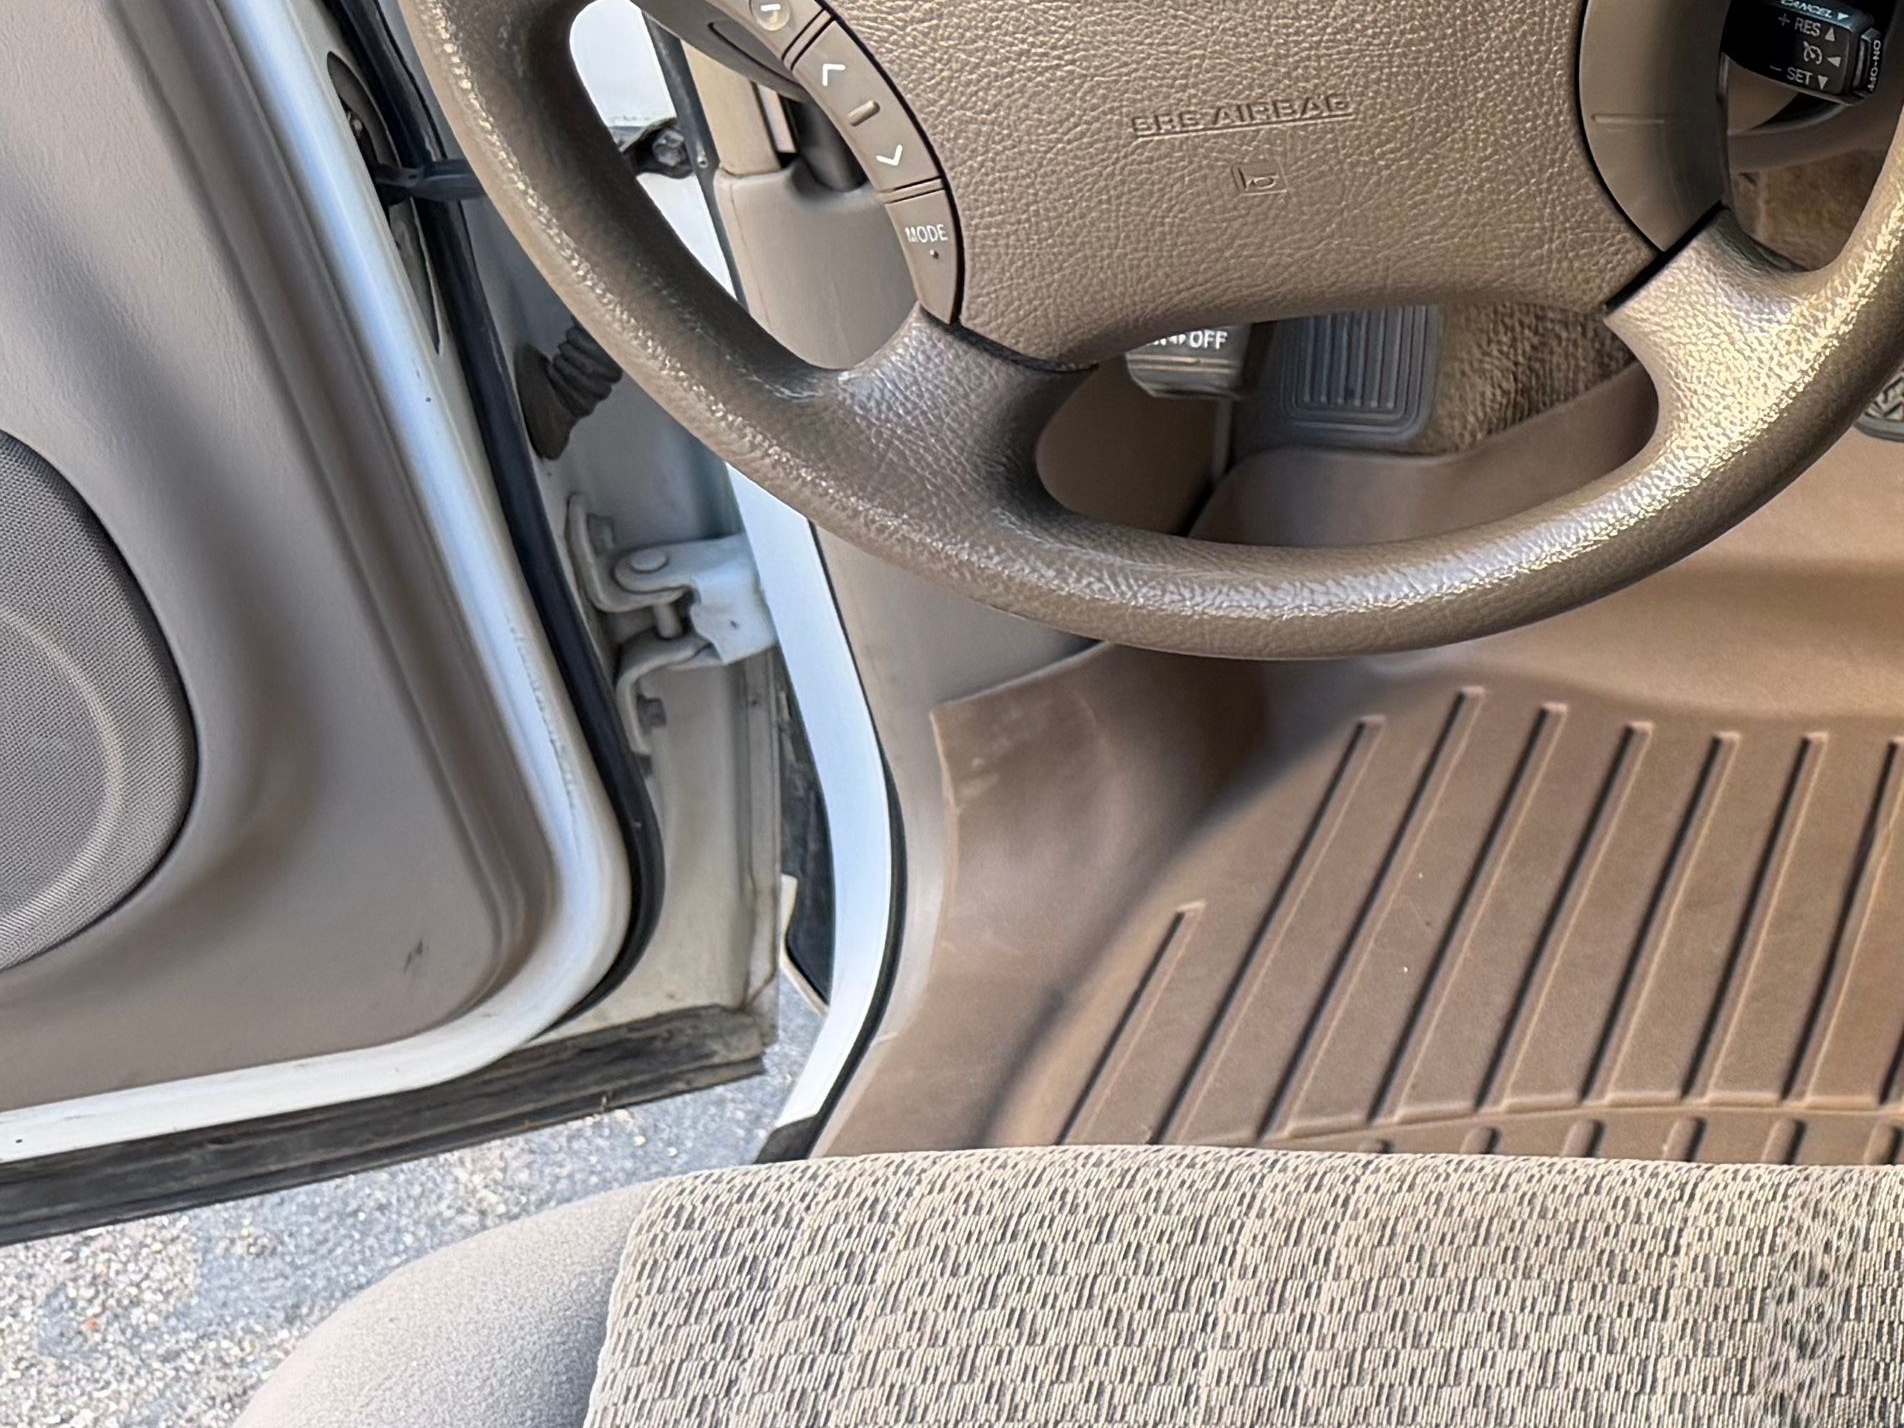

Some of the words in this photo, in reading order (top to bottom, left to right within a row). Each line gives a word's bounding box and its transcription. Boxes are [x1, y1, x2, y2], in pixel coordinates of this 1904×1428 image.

[1794, 17, 1821, 37] RES
[1786, 66, 1814, 85] SET
[904, 223, 949, 243] MODE
[1189, 329, 1228, 349] OFF
